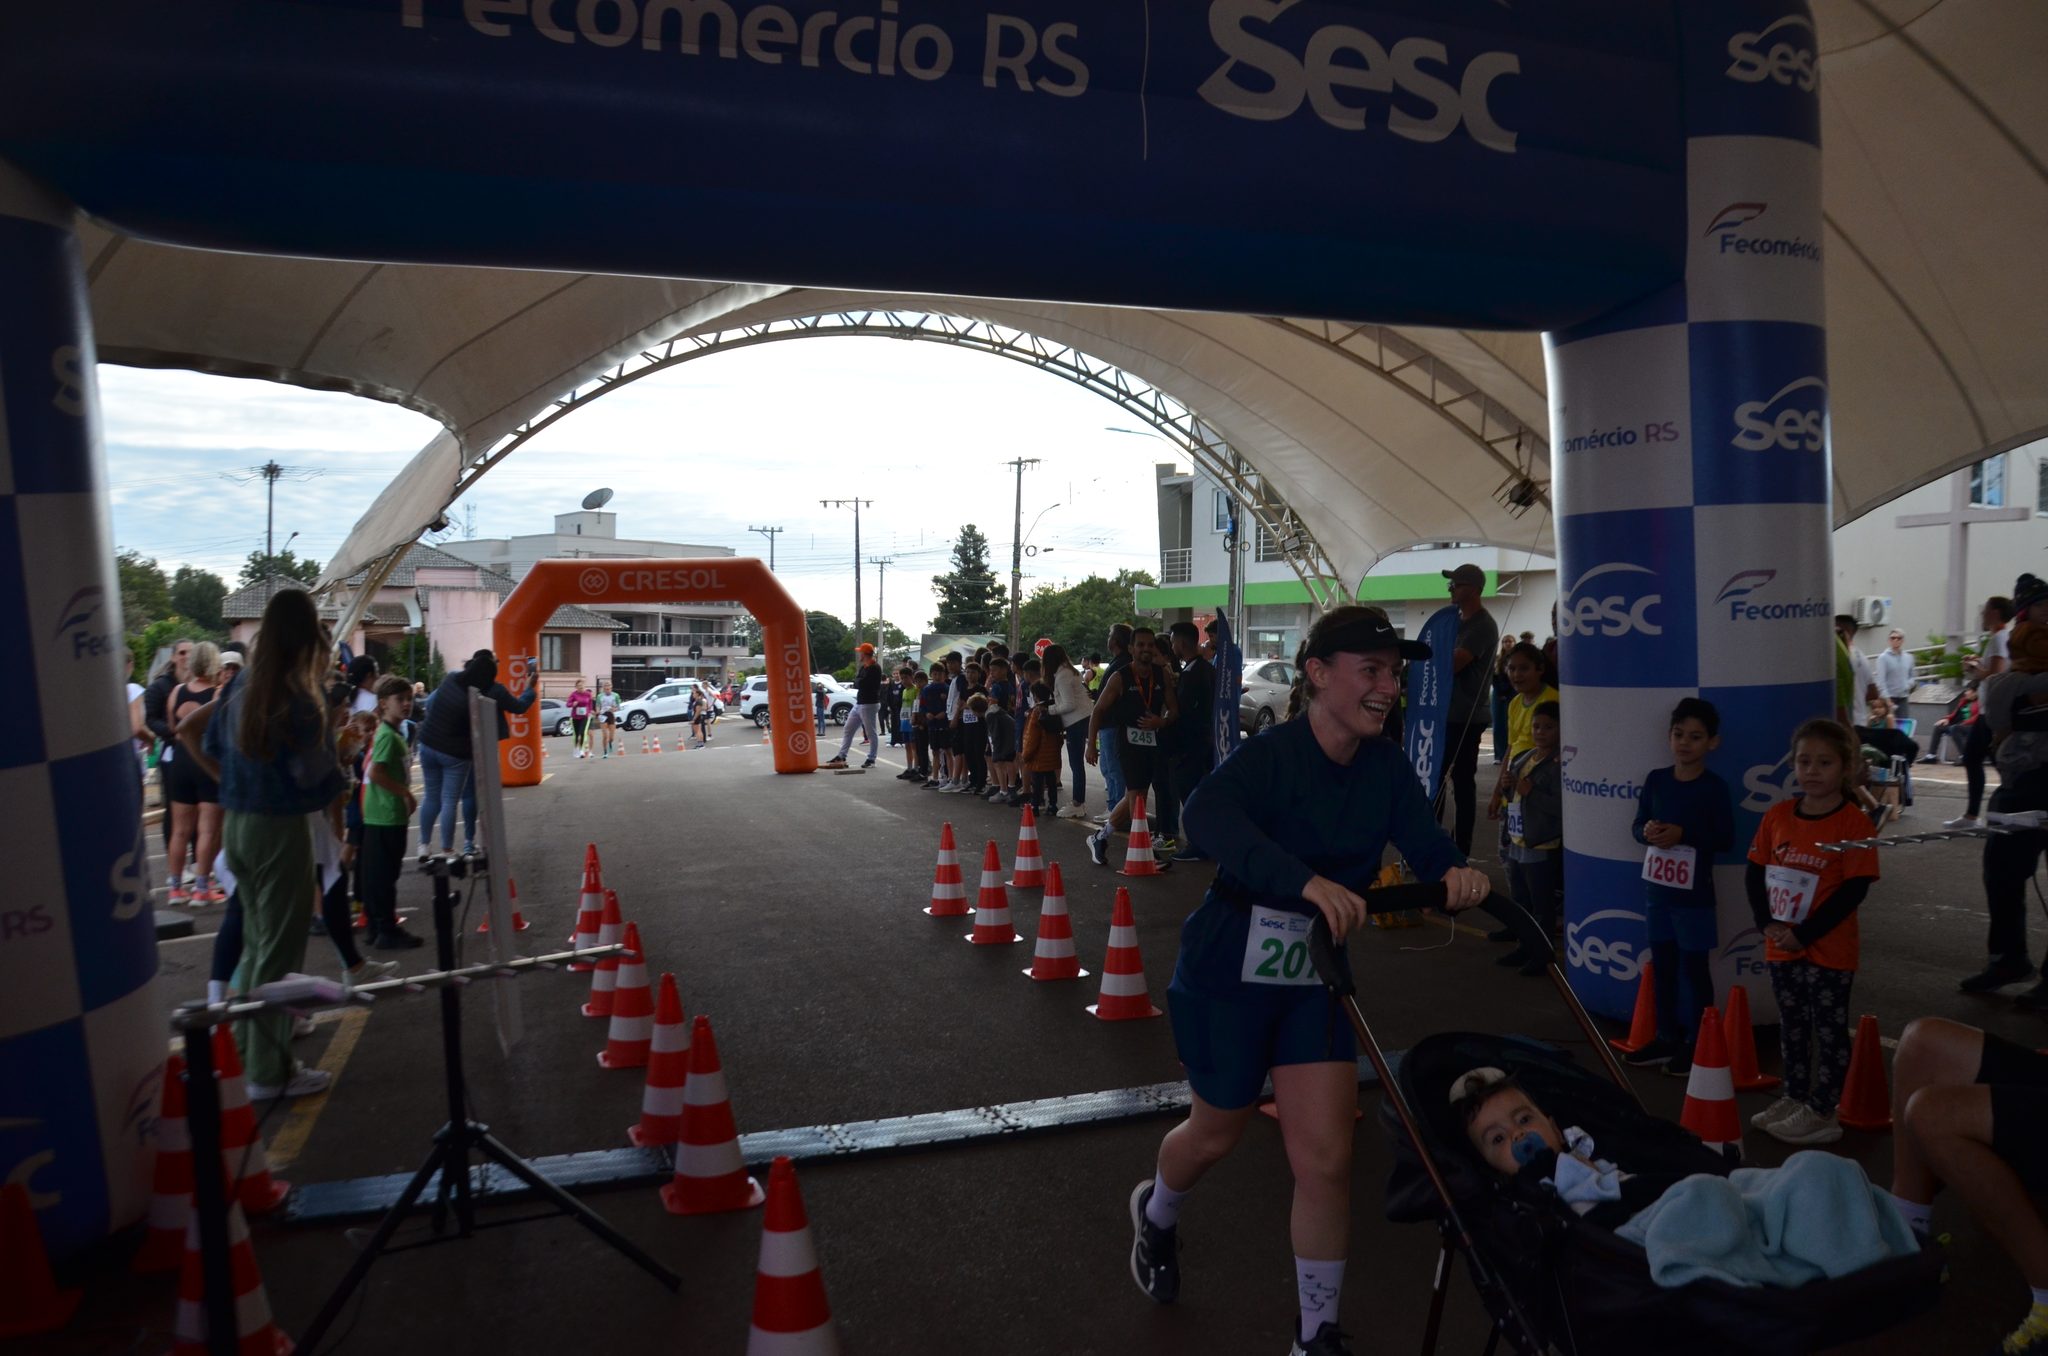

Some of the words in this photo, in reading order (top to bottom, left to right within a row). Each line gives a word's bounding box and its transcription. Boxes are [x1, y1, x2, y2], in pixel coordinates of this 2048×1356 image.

[982, 13, 1090, 97] RS
[1197, 0, 1521, 153] Sesc
[1724, 31, 1819, 92] Ses
[1645, 421, 1679, 443] RS
[1730, 401, 1824, 452] Ses
[618, 569, 726, 591] CRESOL
[784, 637, 806, 723] CRESOL
[1131, 731, 1153, 744] 245
[1260, 917, 1286, 930] Sesc
[1255, 938, 1318, 979] 20
